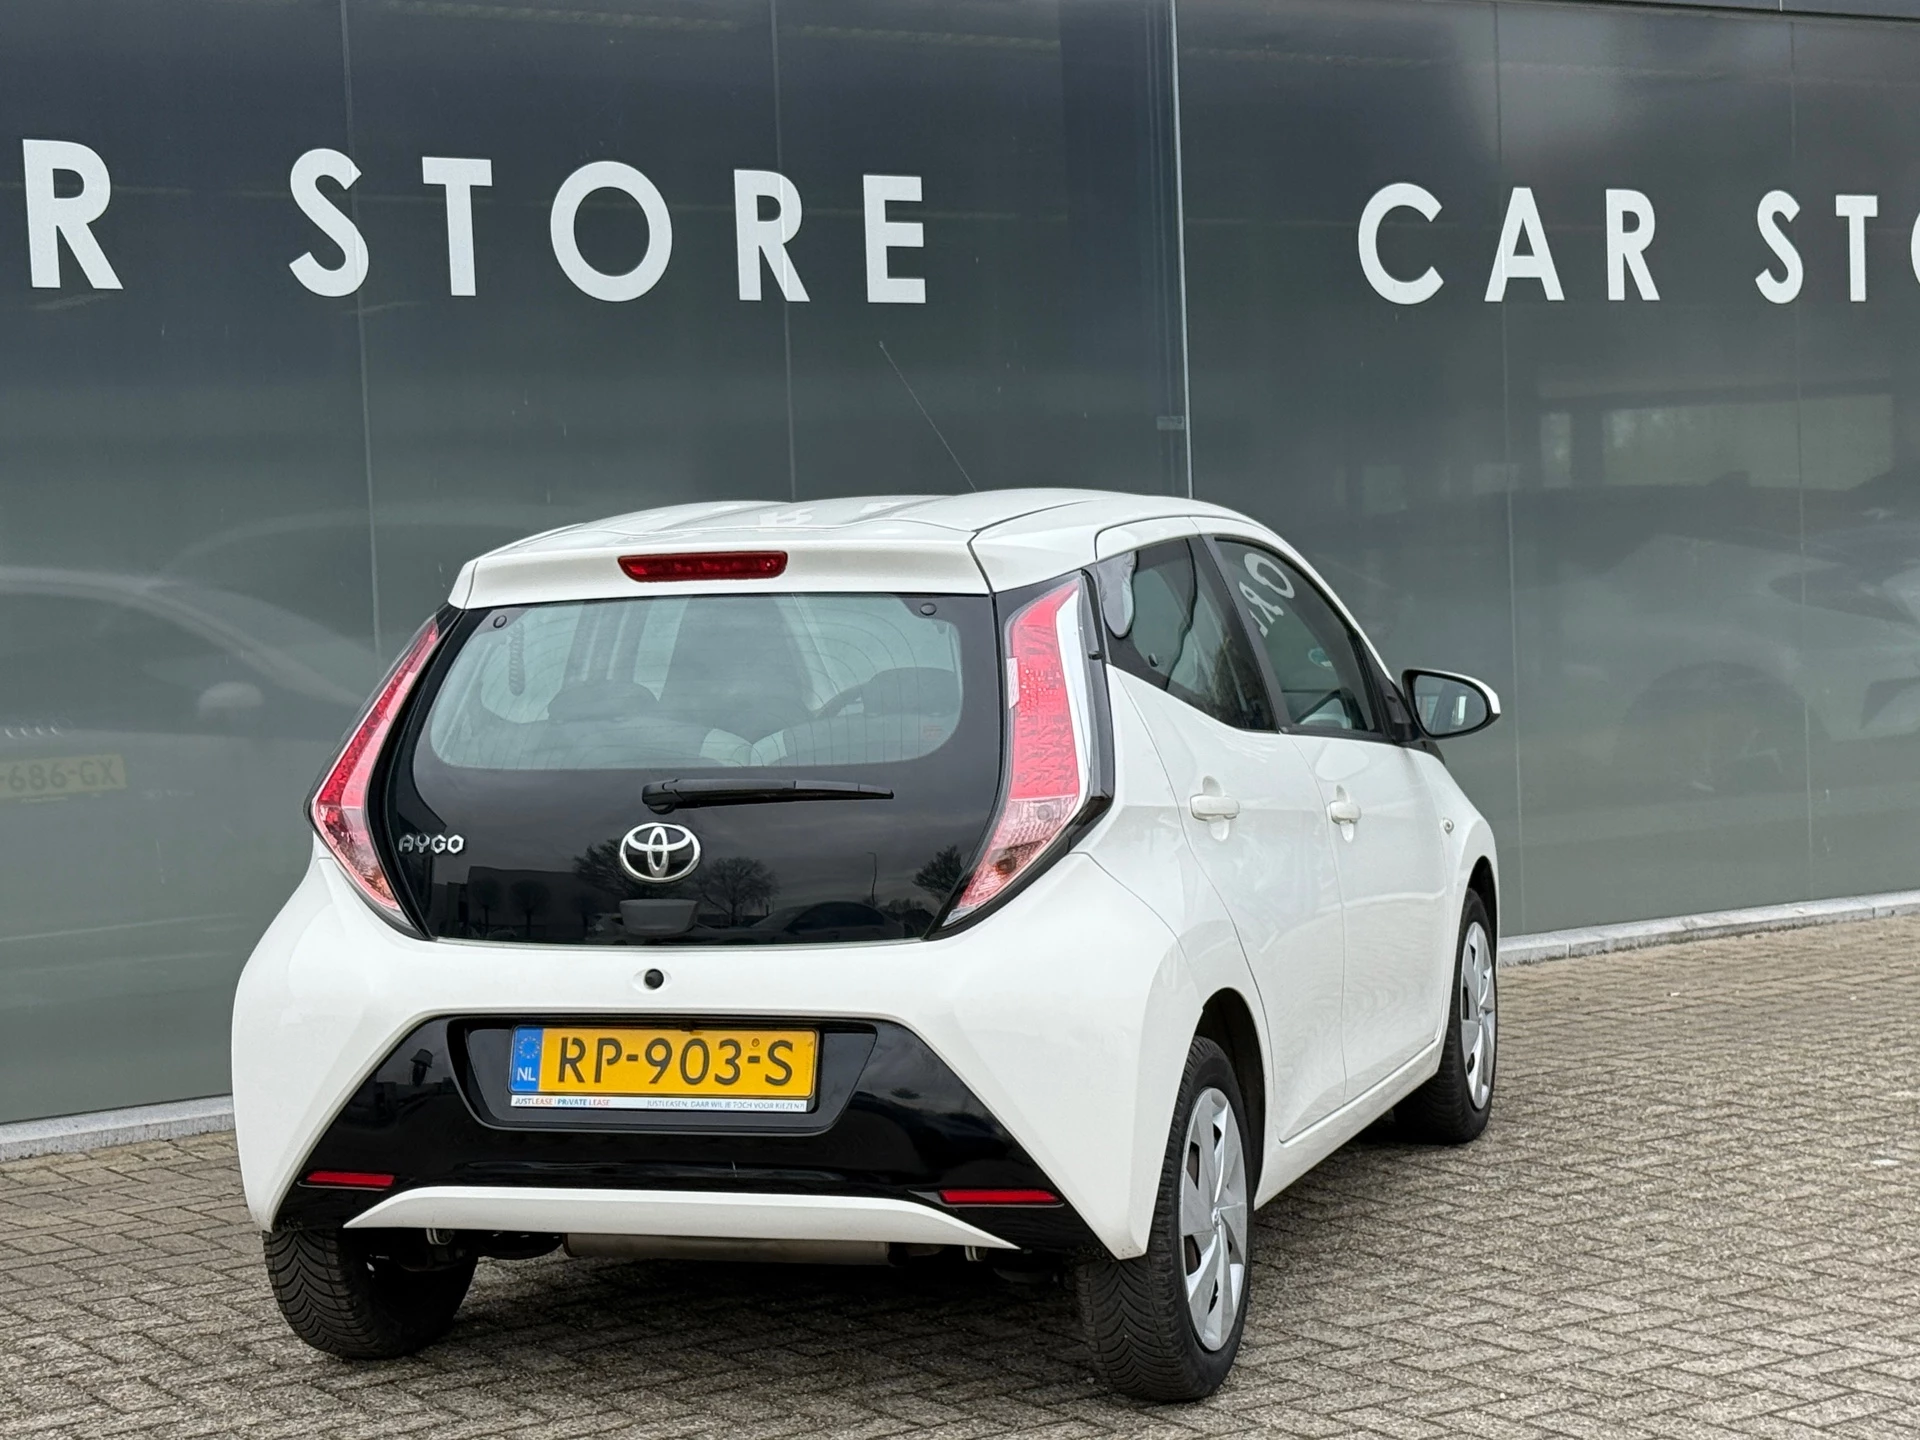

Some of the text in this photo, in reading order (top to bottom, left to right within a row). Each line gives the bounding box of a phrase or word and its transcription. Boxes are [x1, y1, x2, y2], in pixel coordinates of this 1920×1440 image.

[22, 139, 927, 304] R STORE
[1358, 182, 1920, 305] CAR ST
[398, 833, 465, 854] AYGO
[517, 1067, 537, 1082] NL
[557, 1037, 794, 1087] RP-903-S
[690, 1100, 710, 1108] DAAR
[754, 1101, 774, 1109] VOOR
